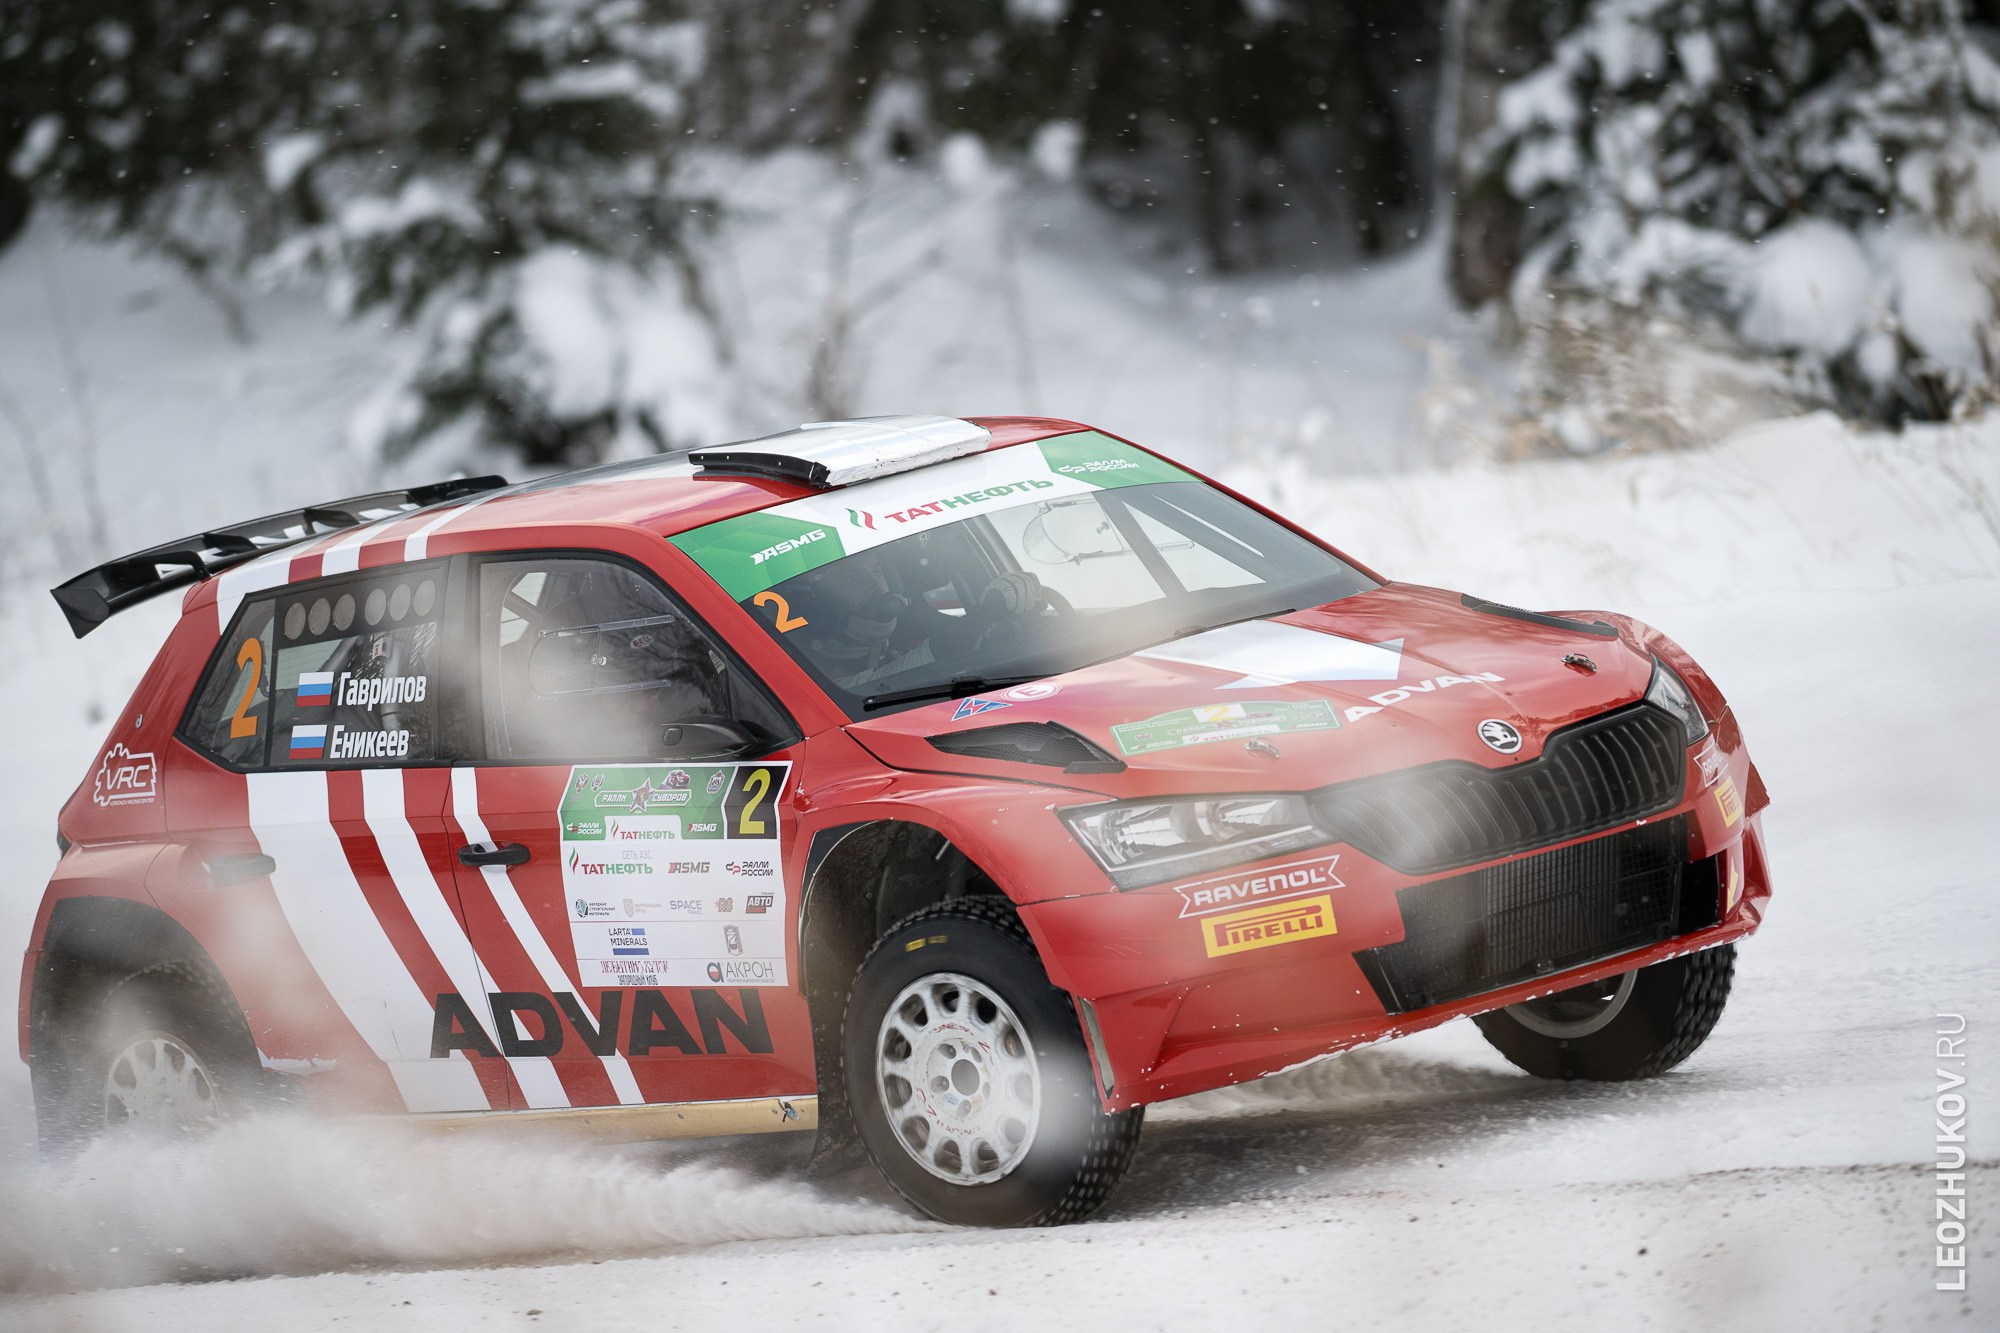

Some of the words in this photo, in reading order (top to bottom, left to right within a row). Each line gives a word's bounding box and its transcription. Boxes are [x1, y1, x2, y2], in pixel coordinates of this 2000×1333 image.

[884, 480, 1054, 523] ТАТНЕФТЬ
[752, 529, 827, 565] ASMG
[753, 590, 809, 634] 2
[229, 637, 263, 739] 2
[337, 671, 427, 712] Гаврилов
[1343, 672, 1507, 723] ADVAN
[1202, 704, 1231, 723] 2
[329, 724, 411, 760] Еникеев
[106, 764, 150, 790] VRC
[601, 793, 628, 803] РАЛЛИ
[651, 792, 688, 802] СУВОРОВ
[740, 768, 771, 834] 2
[620, 830, 676, 840] ТАТНЕФТЬ
[690, 823, 718, 833] ASMG
[621, 850, 638, 860] СЕТЬ
[639, 850, 653, 860] АЗС
[581, 863, 654, 875] ТАТНЕФТЬ
[671, 862, 711, 874] ASMG
[741, 868, 774, 877] РОССИИ
[742, 861, 770, 869] РАЛЛИ
[1193, 867, 1327, 907] RAVENOL
[669, 900, 703, 910] SPACE
[747, 896, 772, 907] АВТО
[608, 927, 631, 936] LARTA
[1213, 904, 1324, 948] PIRELLI
[610, 937, 648, 946] MINERALS
[725, 961, 774, 978] АКРОН
[430, 988, 775, 1060] ADVAN
